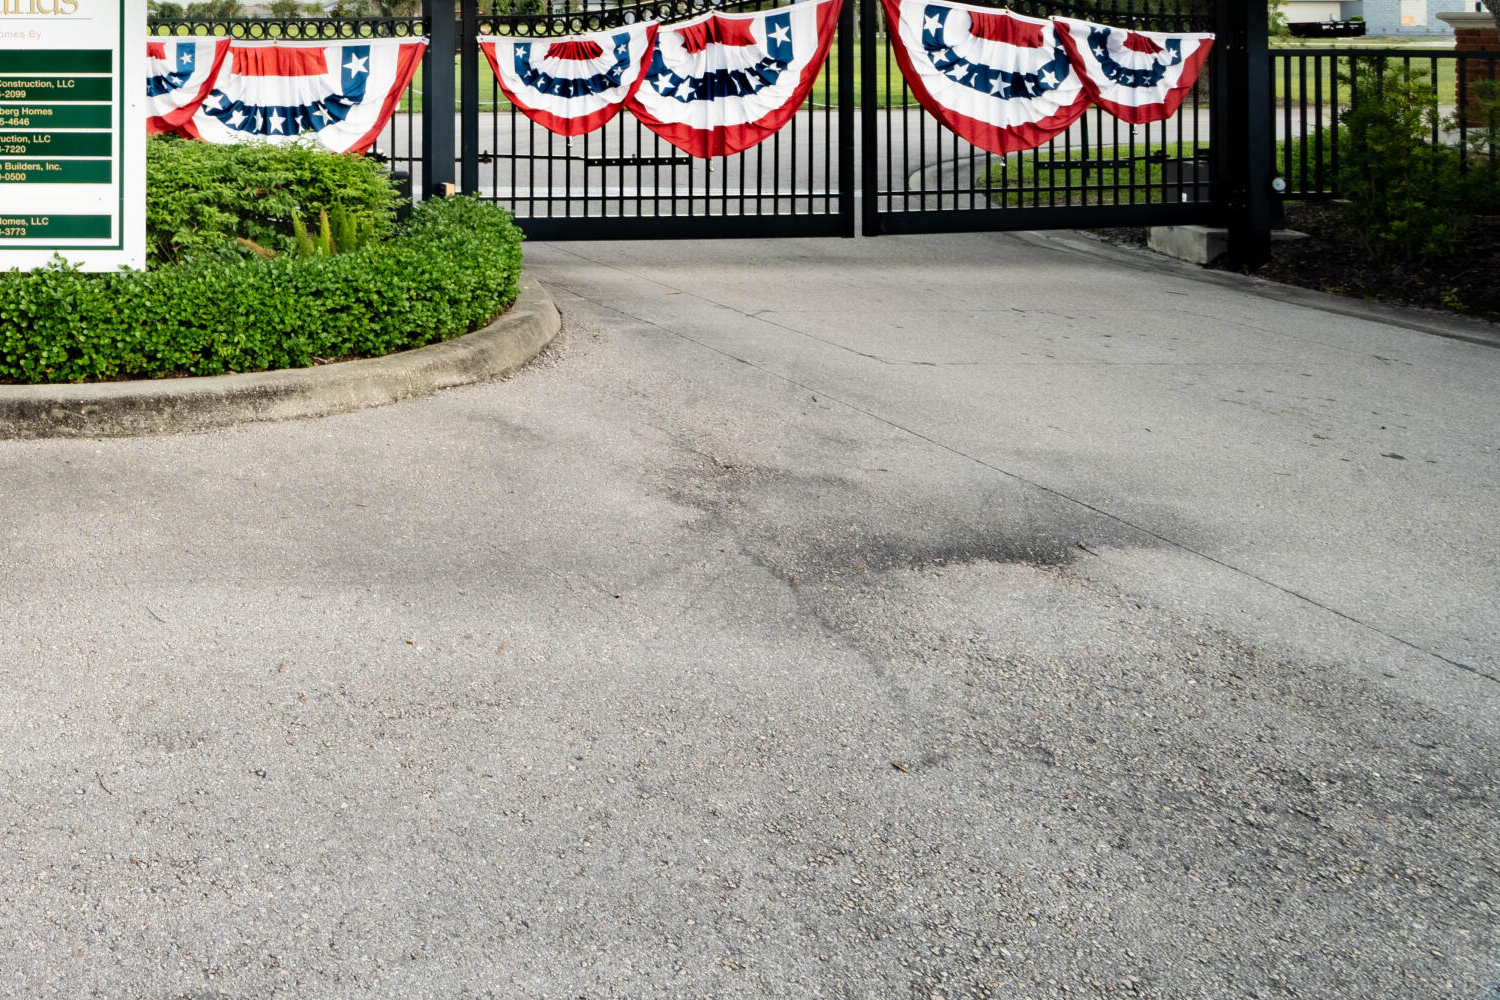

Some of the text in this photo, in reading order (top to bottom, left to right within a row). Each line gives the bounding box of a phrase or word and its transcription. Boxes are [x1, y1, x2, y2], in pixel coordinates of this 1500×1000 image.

[28, 30, 42, 40] By
[56, 80, 76, 88] LLC
[22, 107, 53, 116] Homes
[33, 134, 51, 143] LLC
[4, 162, 44, 172] Builders,
[46, 162, 62, 171] Inc.
[30, 217, 50, 226] LLC
